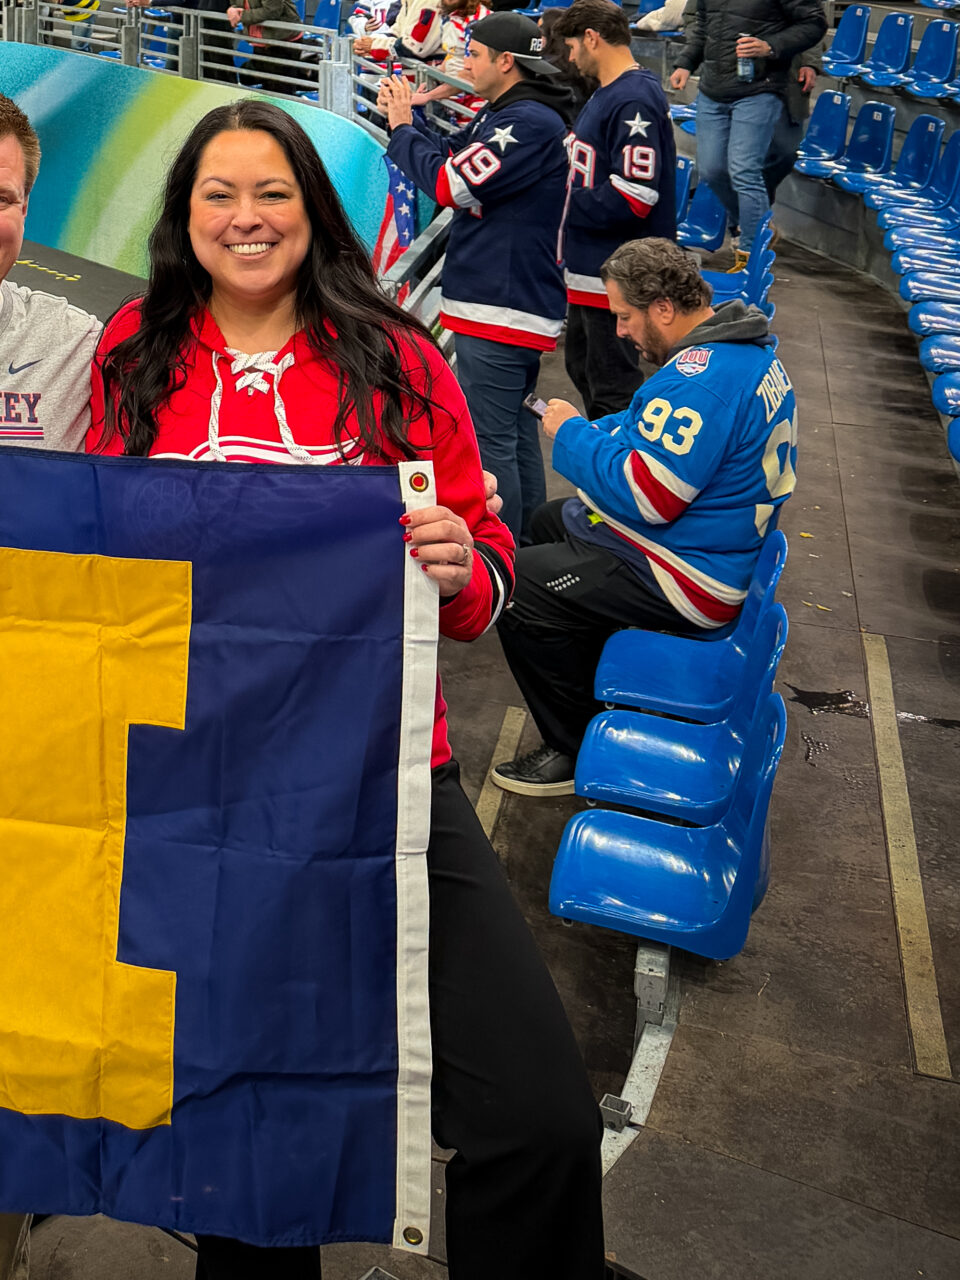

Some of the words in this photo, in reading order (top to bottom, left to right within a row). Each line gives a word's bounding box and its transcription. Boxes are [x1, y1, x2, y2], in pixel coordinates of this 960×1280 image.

[451, 141, 502, 186] 19
[622, 144, 656, 181] 19
[637, 397, 704, 456] 93
